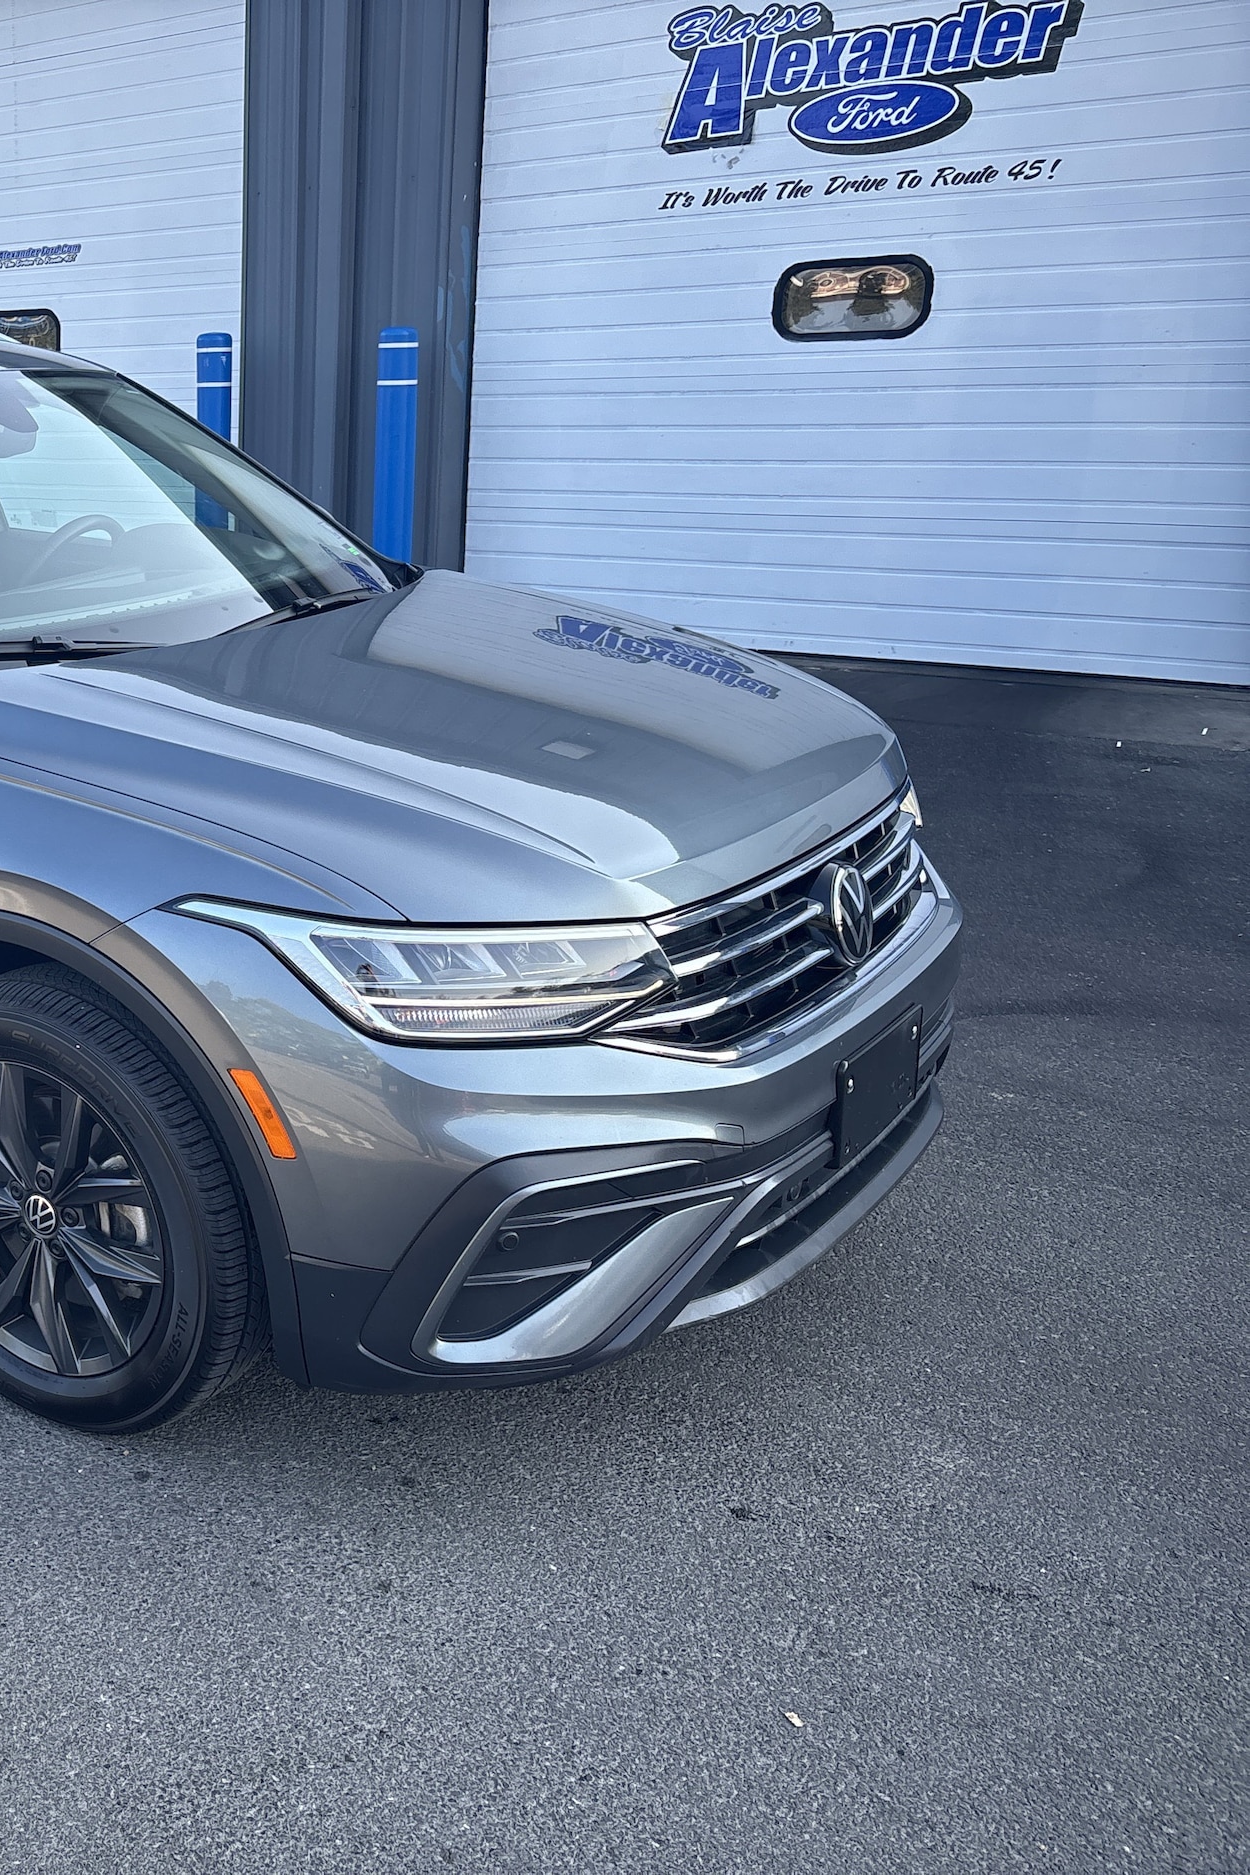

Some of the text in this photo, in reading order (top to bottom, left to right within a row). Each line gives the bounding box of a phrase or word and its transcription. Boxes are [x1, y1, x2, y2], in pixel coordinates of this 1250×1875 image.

[670, 2, 824, 52] Blaise
[664, 0, 1068, 146] Alexander
[827, 90, 918, 134] Ford
[657, 190, 694, 211] It's
[701, 184, 768, 207] Worth
[776, 179, 813, 200] The
[824, 175, 887, 197] Drive
[896, 170, 923, 190] To
[930, 165, 999, 188] Route
